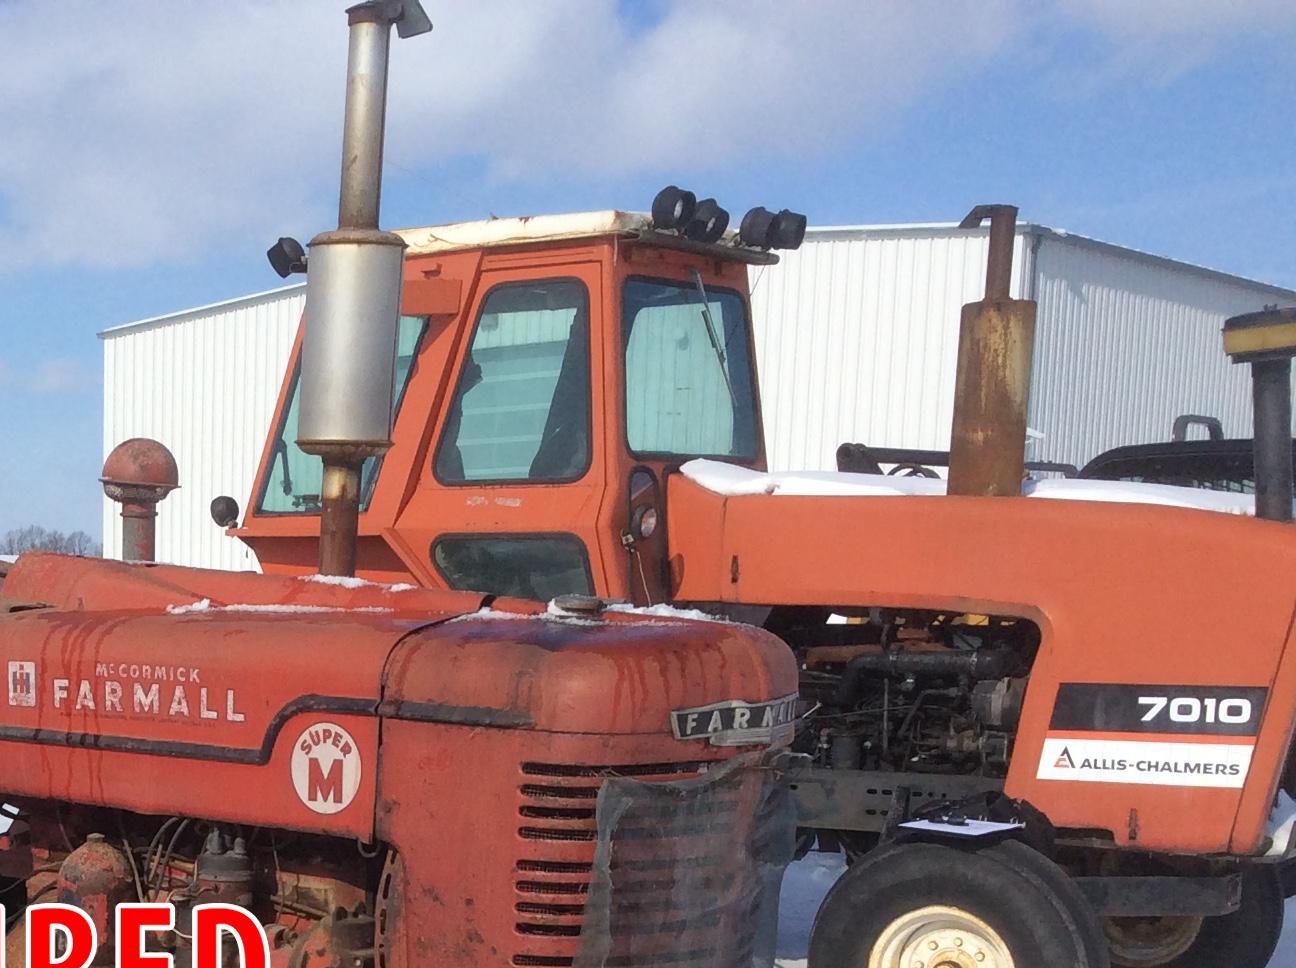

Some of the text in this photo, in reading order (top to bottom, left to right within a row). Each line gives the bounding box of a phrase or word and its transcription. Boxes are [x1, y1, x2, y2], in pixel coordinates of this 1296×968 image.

[53, 678, 246, 722] FARMALL
[1137, 696, 1252, 724] 7010
[300, 728, 353, 758] SUPER
[308, 757, 344, 804] M
[1079, 757, 1241, 777] ALLIS-CHALMERS
